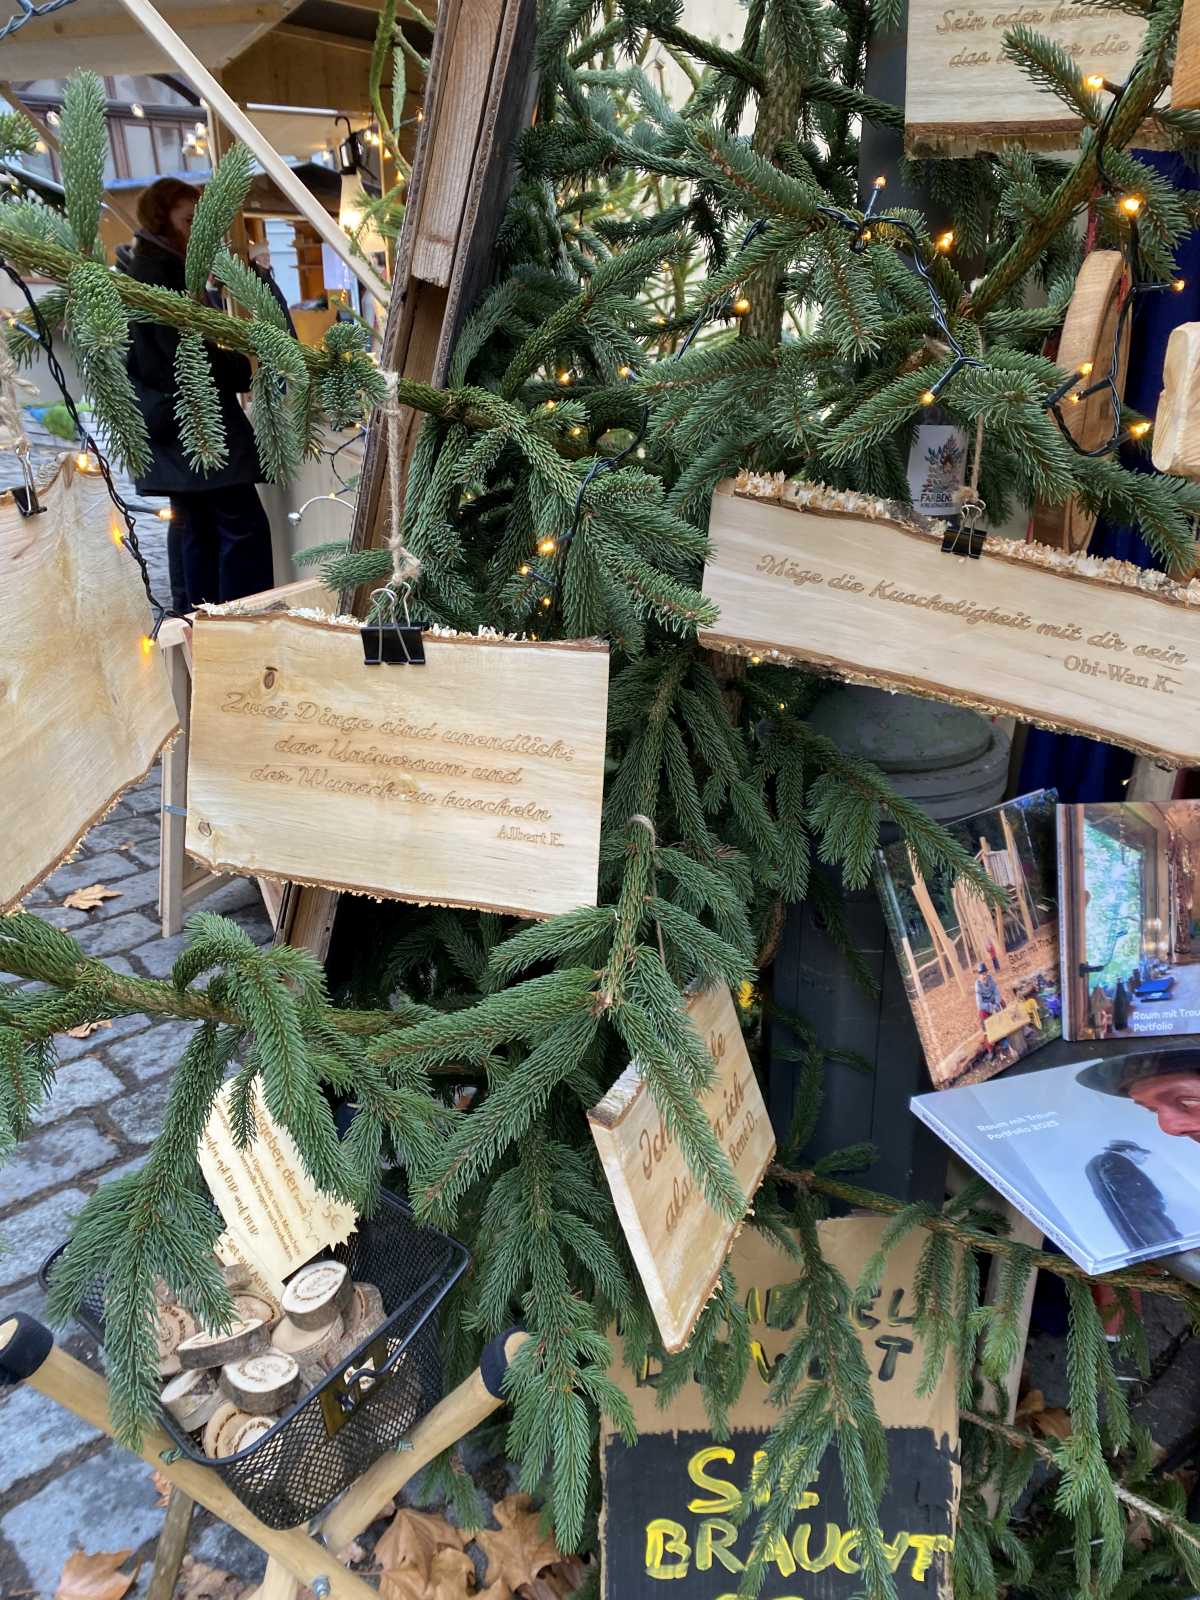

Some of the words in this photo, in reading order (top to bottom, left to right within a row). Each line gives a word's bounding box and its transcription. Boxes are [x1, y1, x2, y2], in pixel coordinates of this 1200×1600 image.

[937, 9, 987, 36] Sein
[992, 5, 1045, 28] oder
[948, 46, 992, 69] das
[1091, 32, 1131, 57] die
[756, 554, 825, 587] Möge
[827, 573, 865, 594] die
[868, 579, 1032, 631] Kuscheligkeit
[1036, 622, 1082, 642] mit
[1087, 631, 1128, 652] dir
[1133, 645, 1188, 666] sein
[1063, 653, 1150, 689] Obi-Wan
[1152, 673, 1176, 694] K.
[220, 691, 289, 720] Zwei
[294, 701, 374, 735] Dinge
[379, 717, 438, 742] sind
[441, 729, 577, 762] unendlich:
[274, 735, 322, 756] das
[328, 738, 468, 777] Universum
[472, 767, 523, 785] und
[251, 764, 293, 782] der
[298, 766, 401, 800] Wunsch
[441, 789, 552, 823] kuscheln
[496, 824, 546, 844] Albert
[1132, 1011, 1160, 1021] Raum
[1162, 1008, 1178, 1019] mit
[1133, 1023, 1174, 1033] Portfolio
[320, 1204, 345, 1231] 5€
